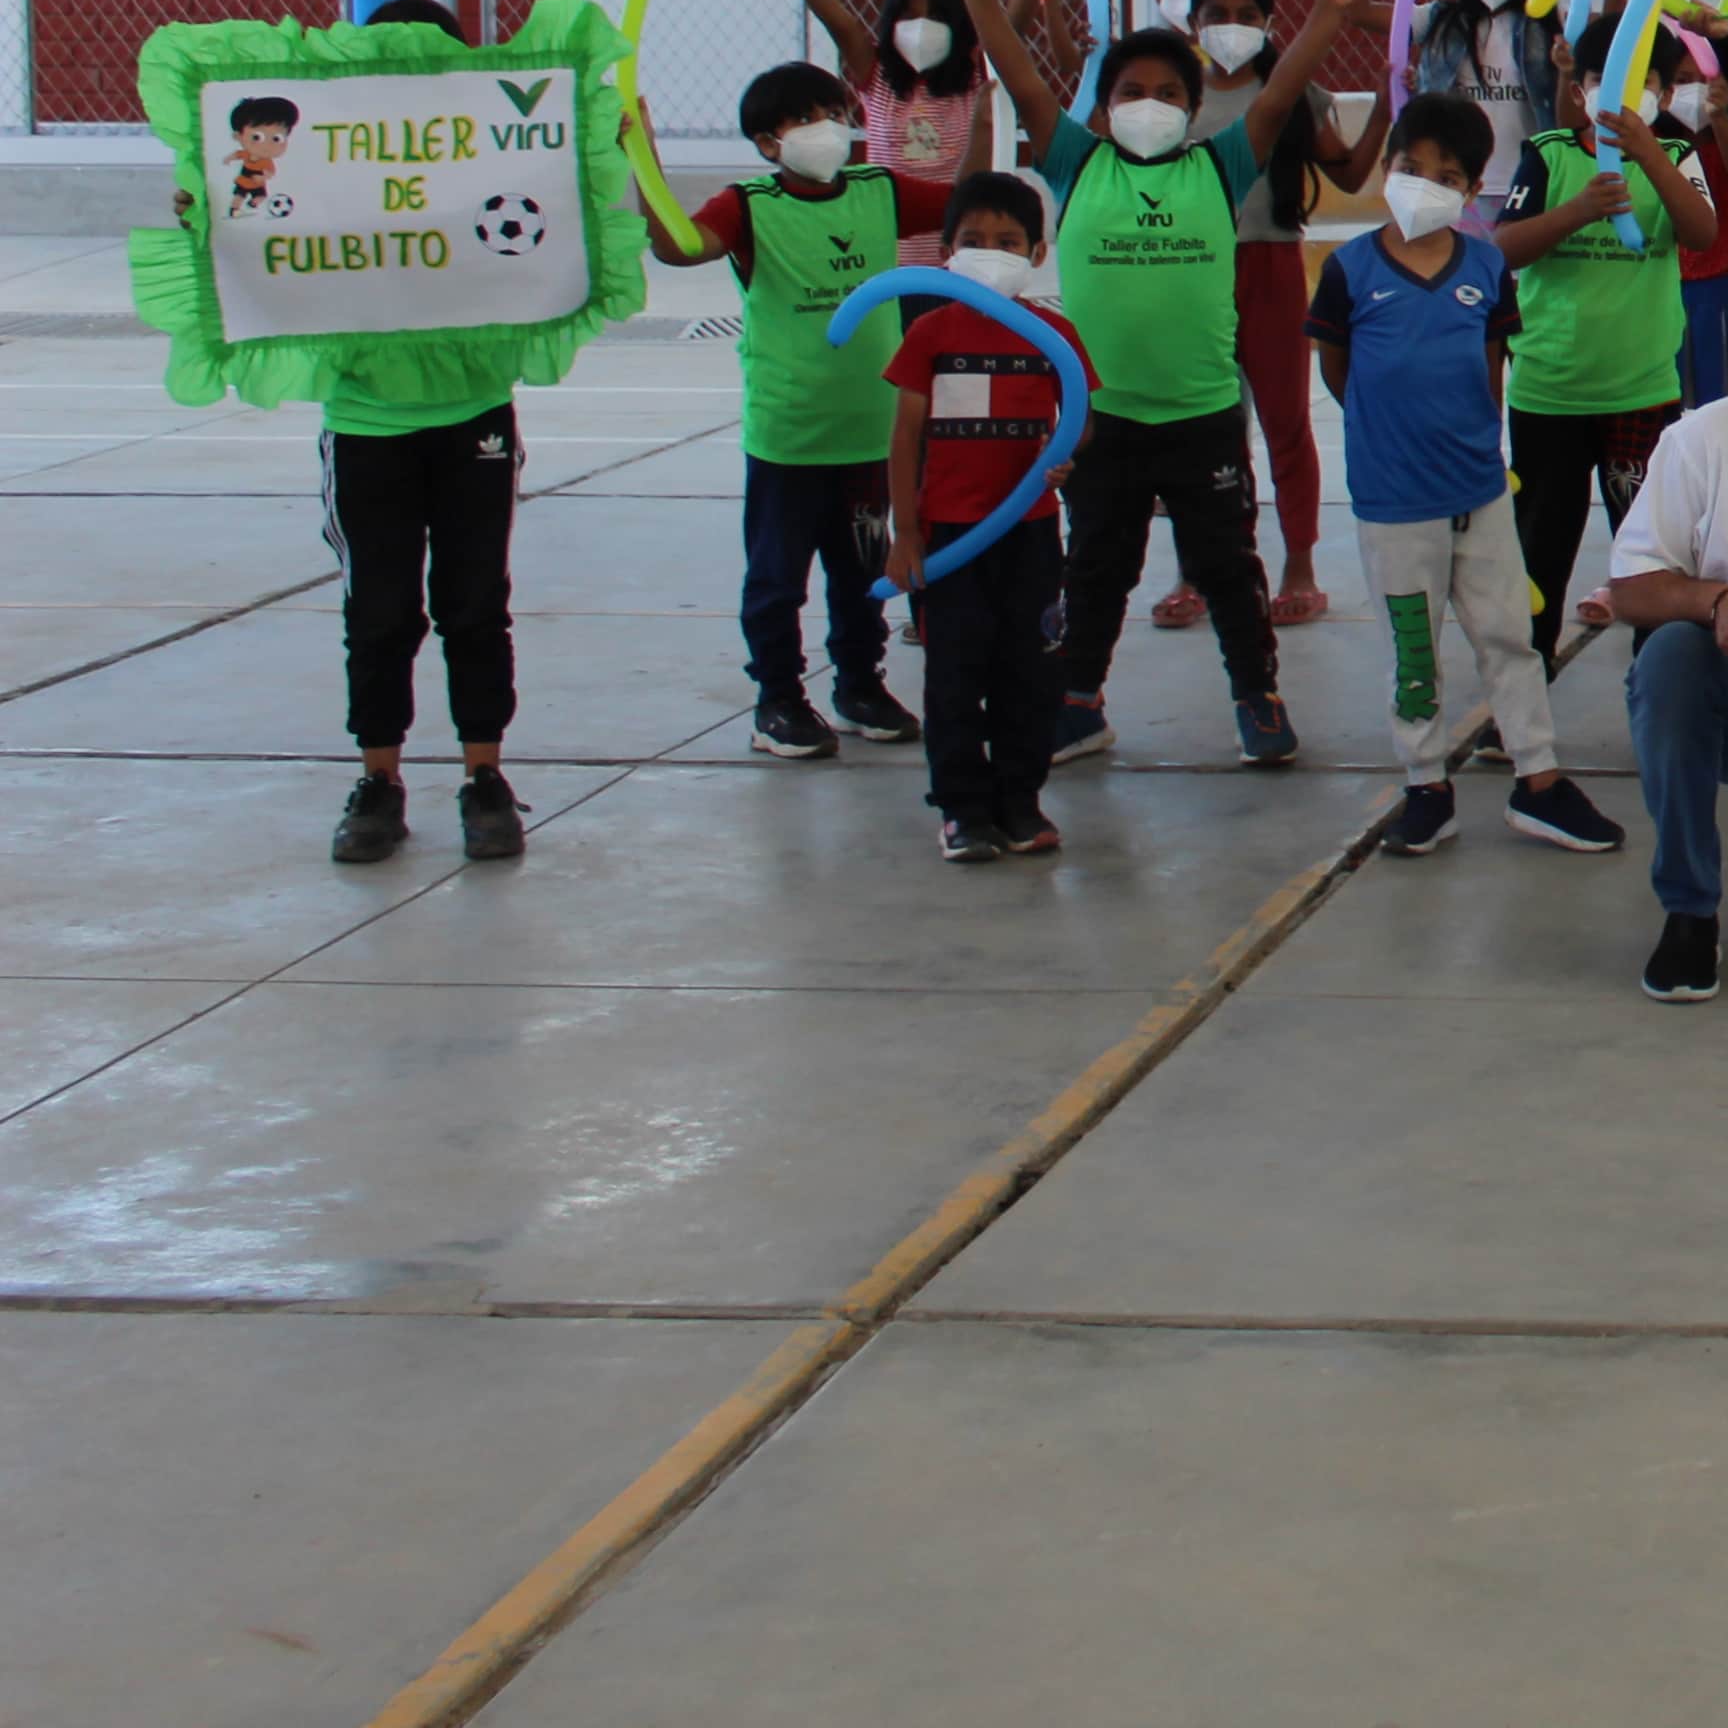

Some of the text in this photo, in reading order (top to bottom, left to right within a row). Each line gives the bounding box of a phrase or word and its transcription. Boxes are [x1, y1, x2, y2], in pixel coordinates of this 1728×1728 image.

[311, 115, 477, 163] TALLER
[382, 175, 426, 212] DE
[264, 230, 450, 274] FULBITO
